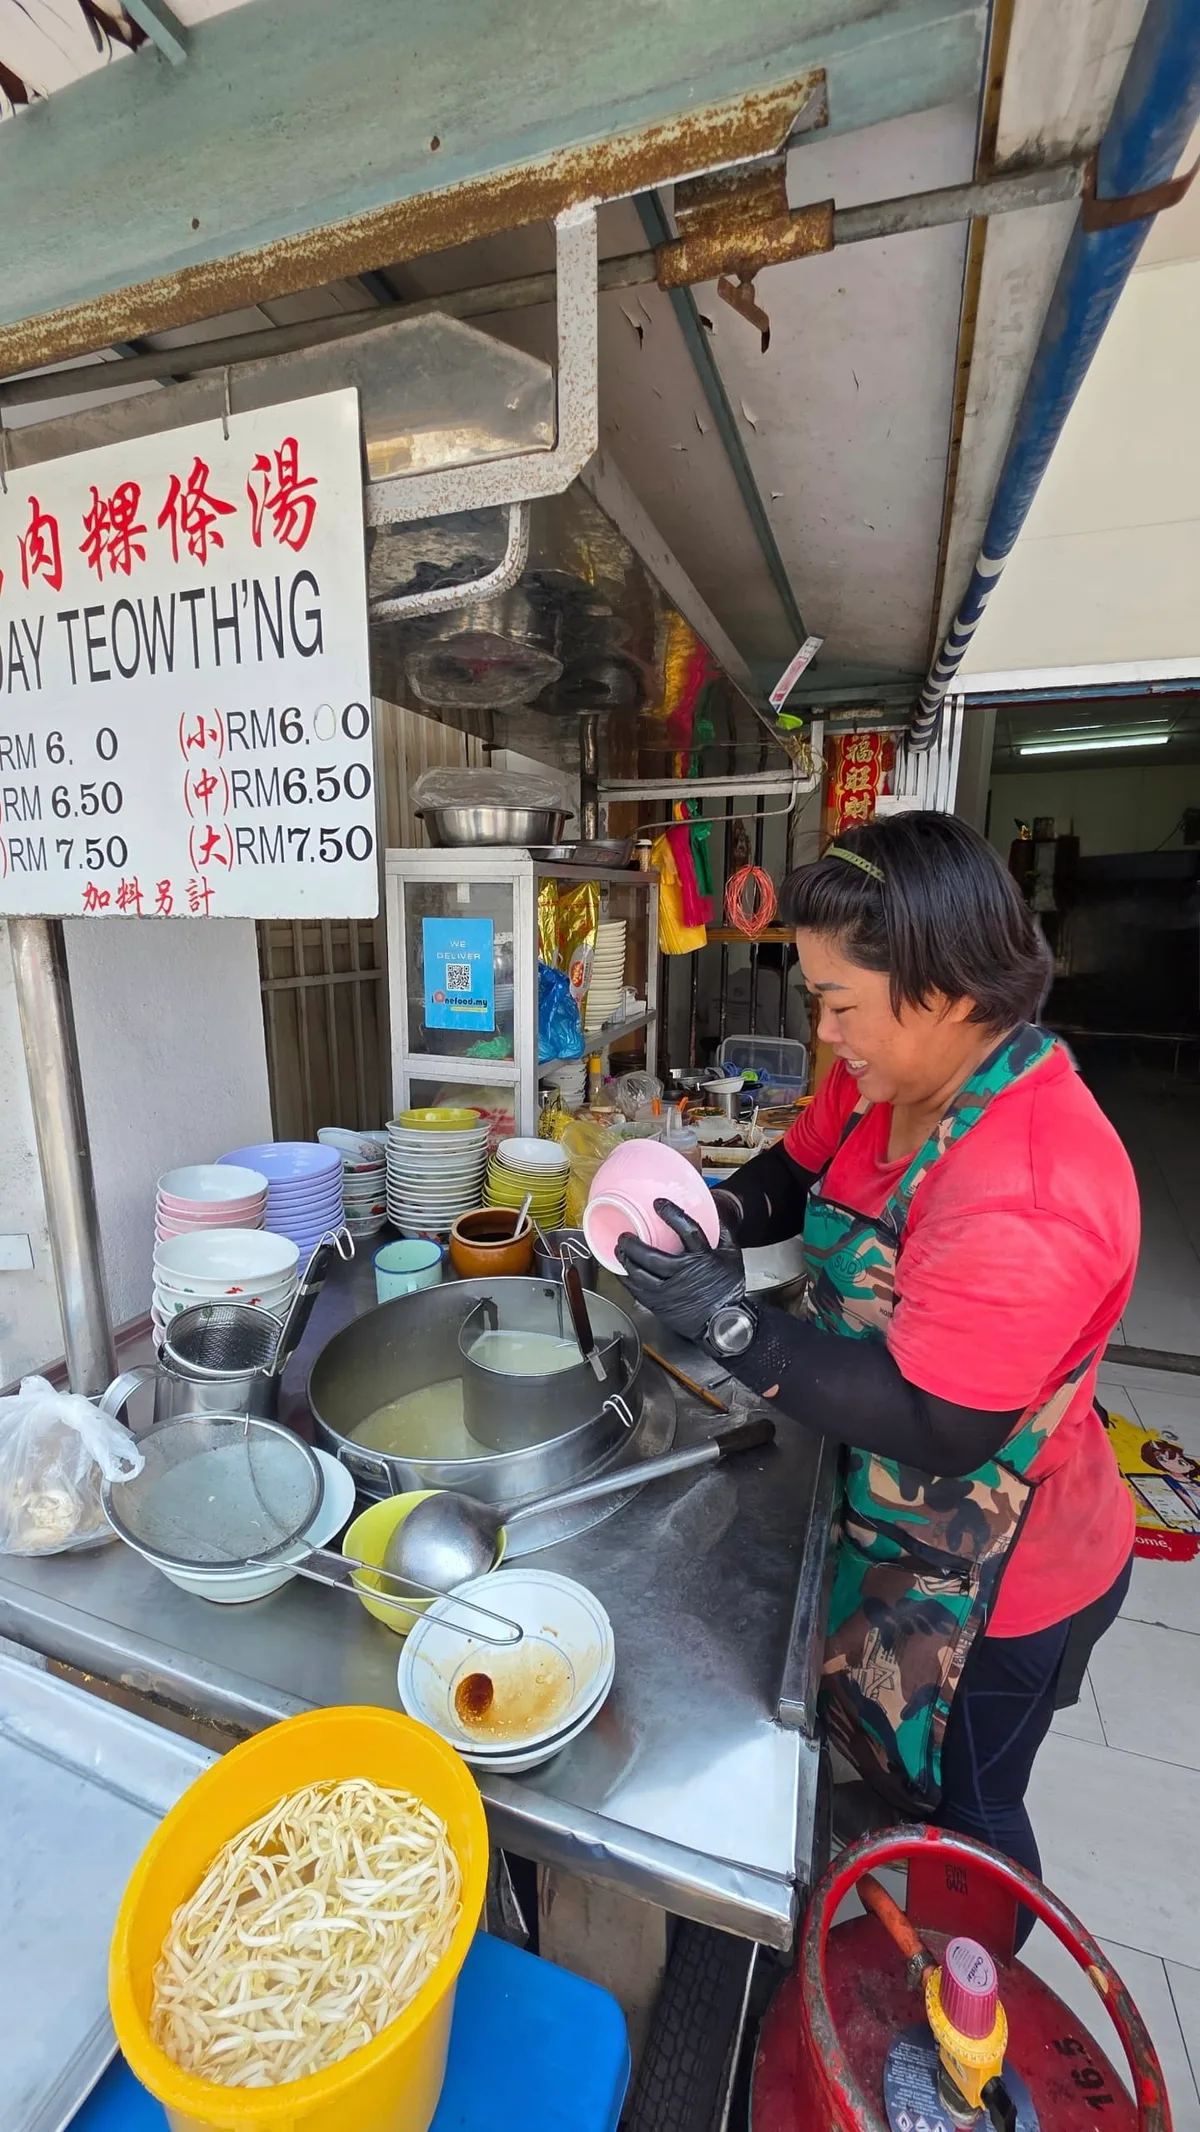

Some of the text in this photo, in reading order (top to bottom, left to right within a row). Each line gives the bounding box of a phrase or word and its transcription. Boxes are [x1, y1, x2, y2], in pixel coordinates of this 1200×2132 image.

[0, 437, 319, 592] 肉粿條湯
[0, 615, 45, 695] AY
[51, 781, 123, 819] 6.50
[843, 734, 874, 828] 福旺財
[56, 835, 128, 870] 7.50
[82, 875, 215, 918] 加料另計
[436, 952, 481, 960] DELIVER
[450, 940, 466, 948] WE
[1134, 1536, 1173, 1552] ome,
